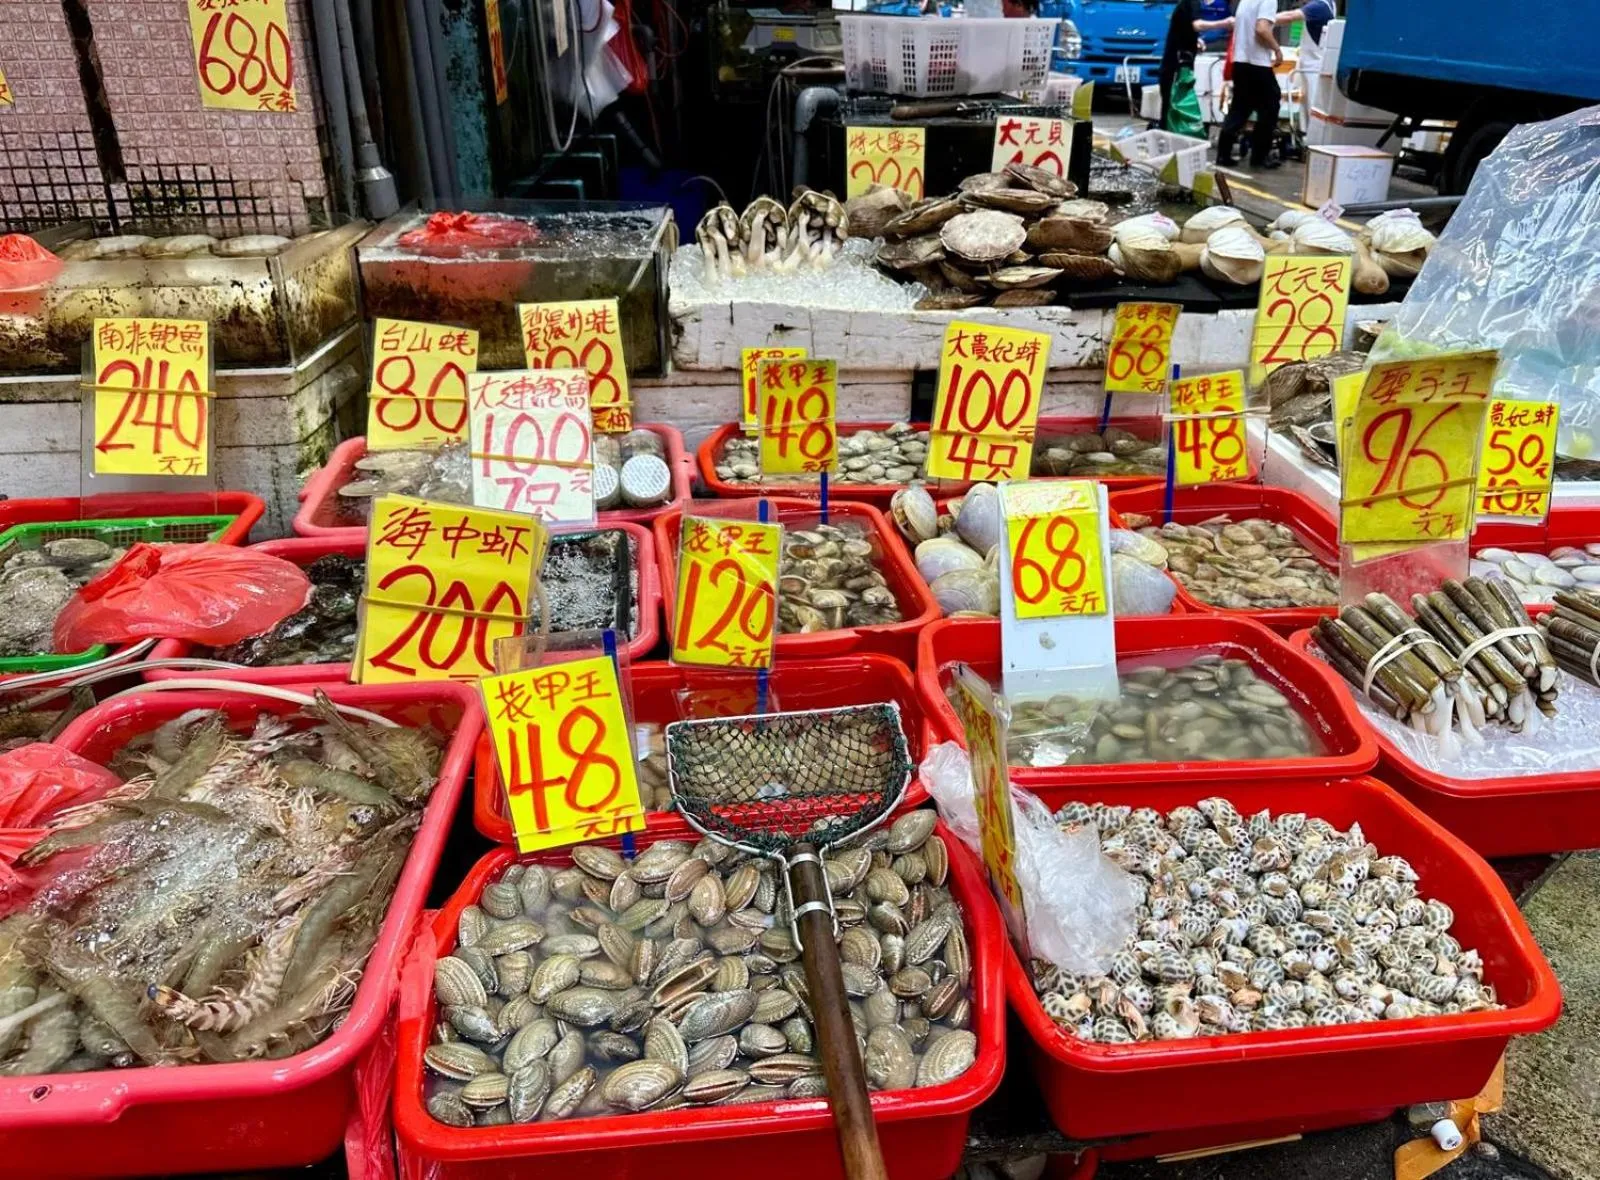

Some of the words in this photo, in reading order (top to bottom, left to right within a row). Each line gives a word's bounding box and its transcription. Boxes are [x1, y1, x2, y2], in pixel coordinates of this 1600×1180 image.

[199, 12, 293, 96] 680
[999, 118, 1064, 146] 大元貝
[1266, 260, 1344, 296] 大元貝
[1108, 325, 1165, 380] 68
[1259, 292, 1338, 364] 28
[95, 356, 207, 455] 240
[375, 355, 469, 434] 80
[764, 386, 834, 459] 48
[939, 363, 1032, 434] 100
[481, 412, 591, 479] 100
[946, 433, 1018, 481] 4只
[1017, 425, 1036, 444] 元
[1177, 404, 1244, 470] 48
[1362, 402, 1461, 511] 96
[1487, 429, 1545, 476] 50
[569, 472, 592, 494] 元
[1482, 476, 1542, 515] 10只
[1533, 462, 1550, 480] 元
[1012, 515, 1087, 606] 68
[369, 564, 525, 677] 200
[677, 558, 775, 651] 120
[1060, 591, 1101, 613] 元斤
[507, 705, 622, 834] 48
